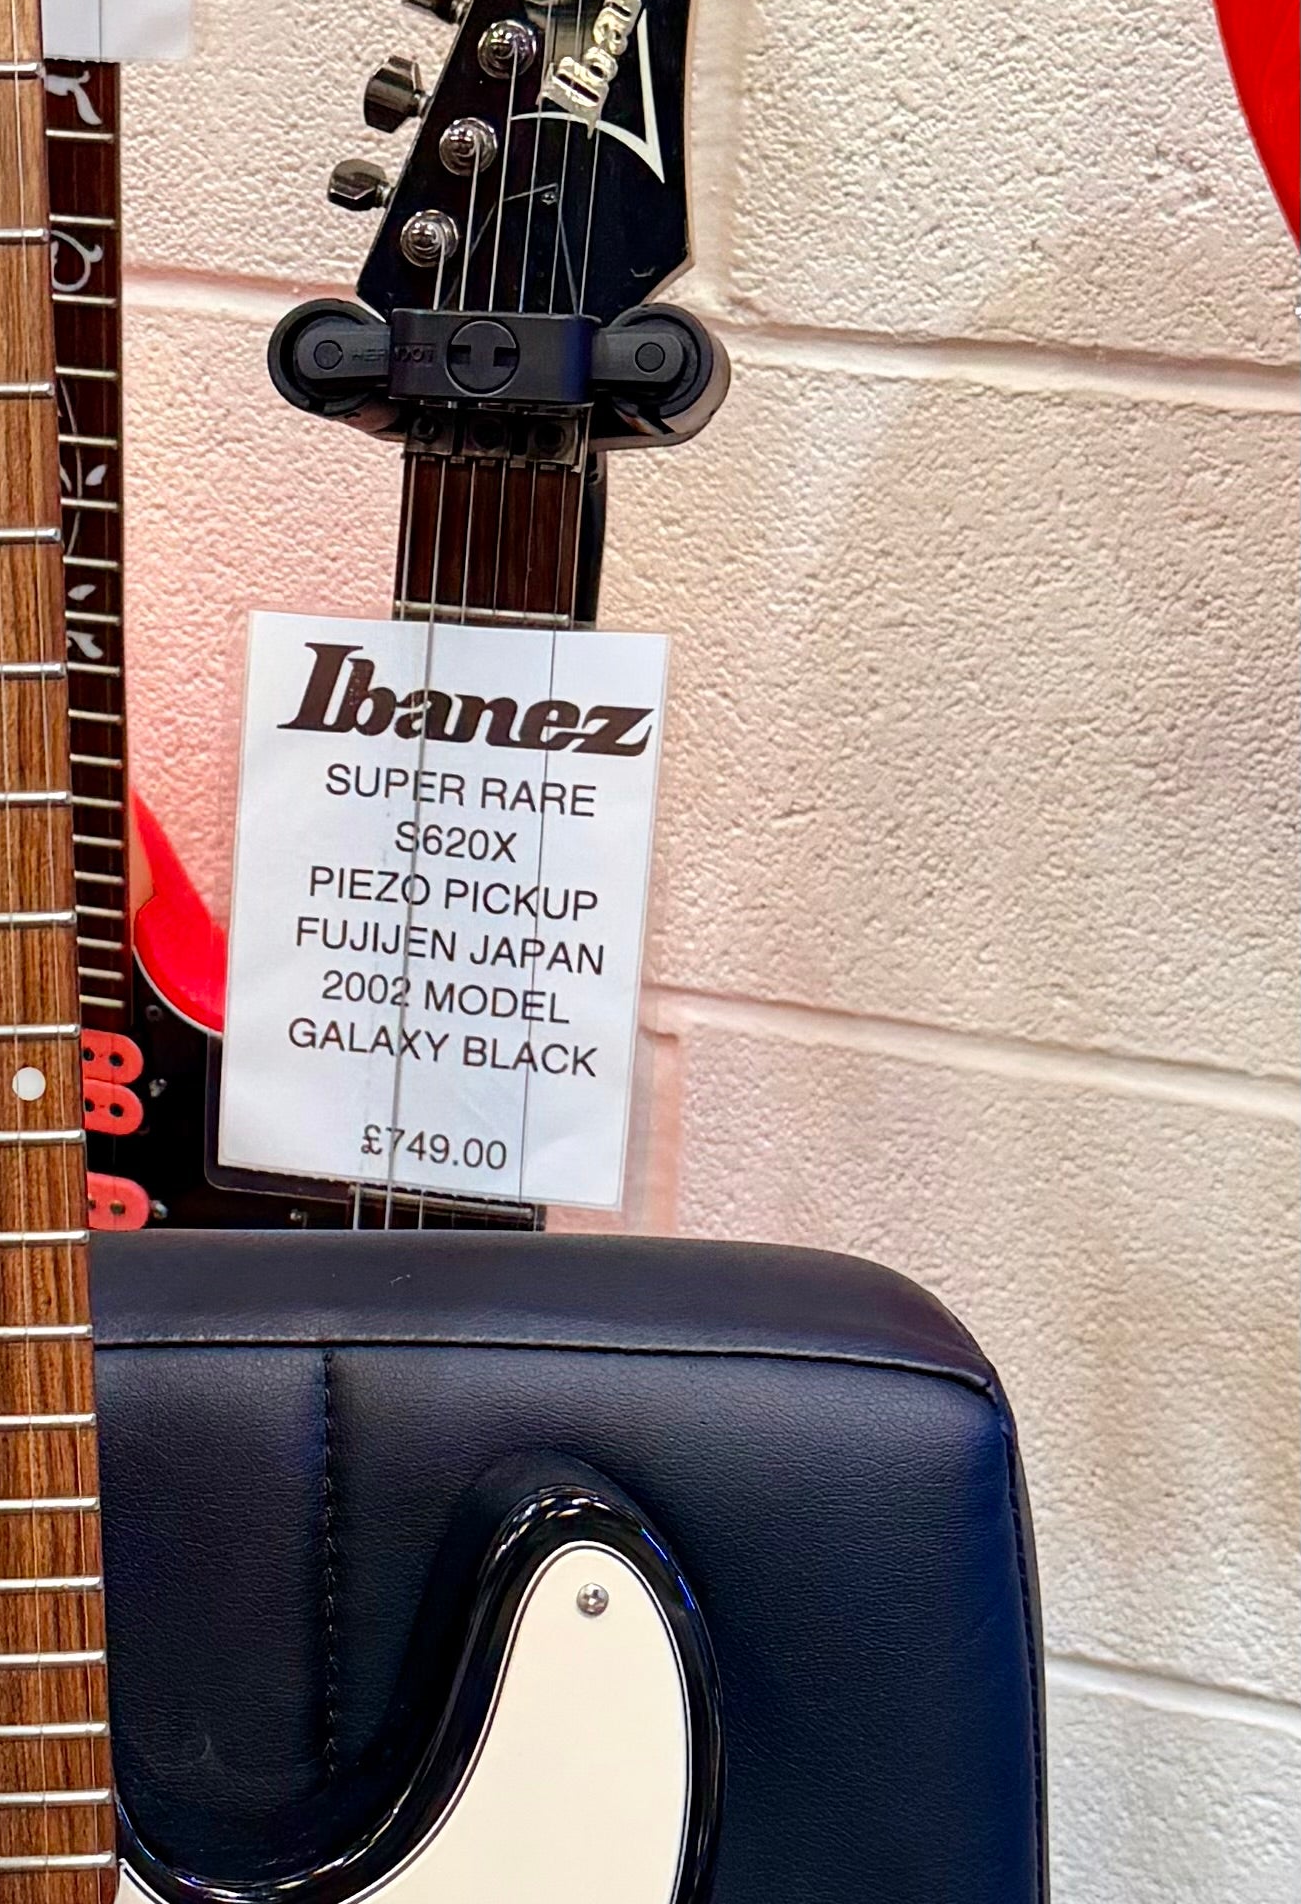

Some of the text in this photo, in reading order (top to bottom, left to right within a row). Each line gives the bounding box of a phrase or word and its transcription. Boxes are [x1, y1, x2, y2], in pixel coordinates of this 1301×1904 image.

[277, 642, 655, 758] Ibanez
[325, 763, 597, 818] SUPER RARE
[394, 821, 517, 863] S620X
[309, 865, 599, 922] PIEZO PICKUP
[296, 916, 604, 976] FUJIJEN JAPAN
[321, 969, 570, 1024] 2002 MODEL
[288, 1017, 599, 1078] GALAXY BLACK
[360, 1124, 508, 1171] £749.00
